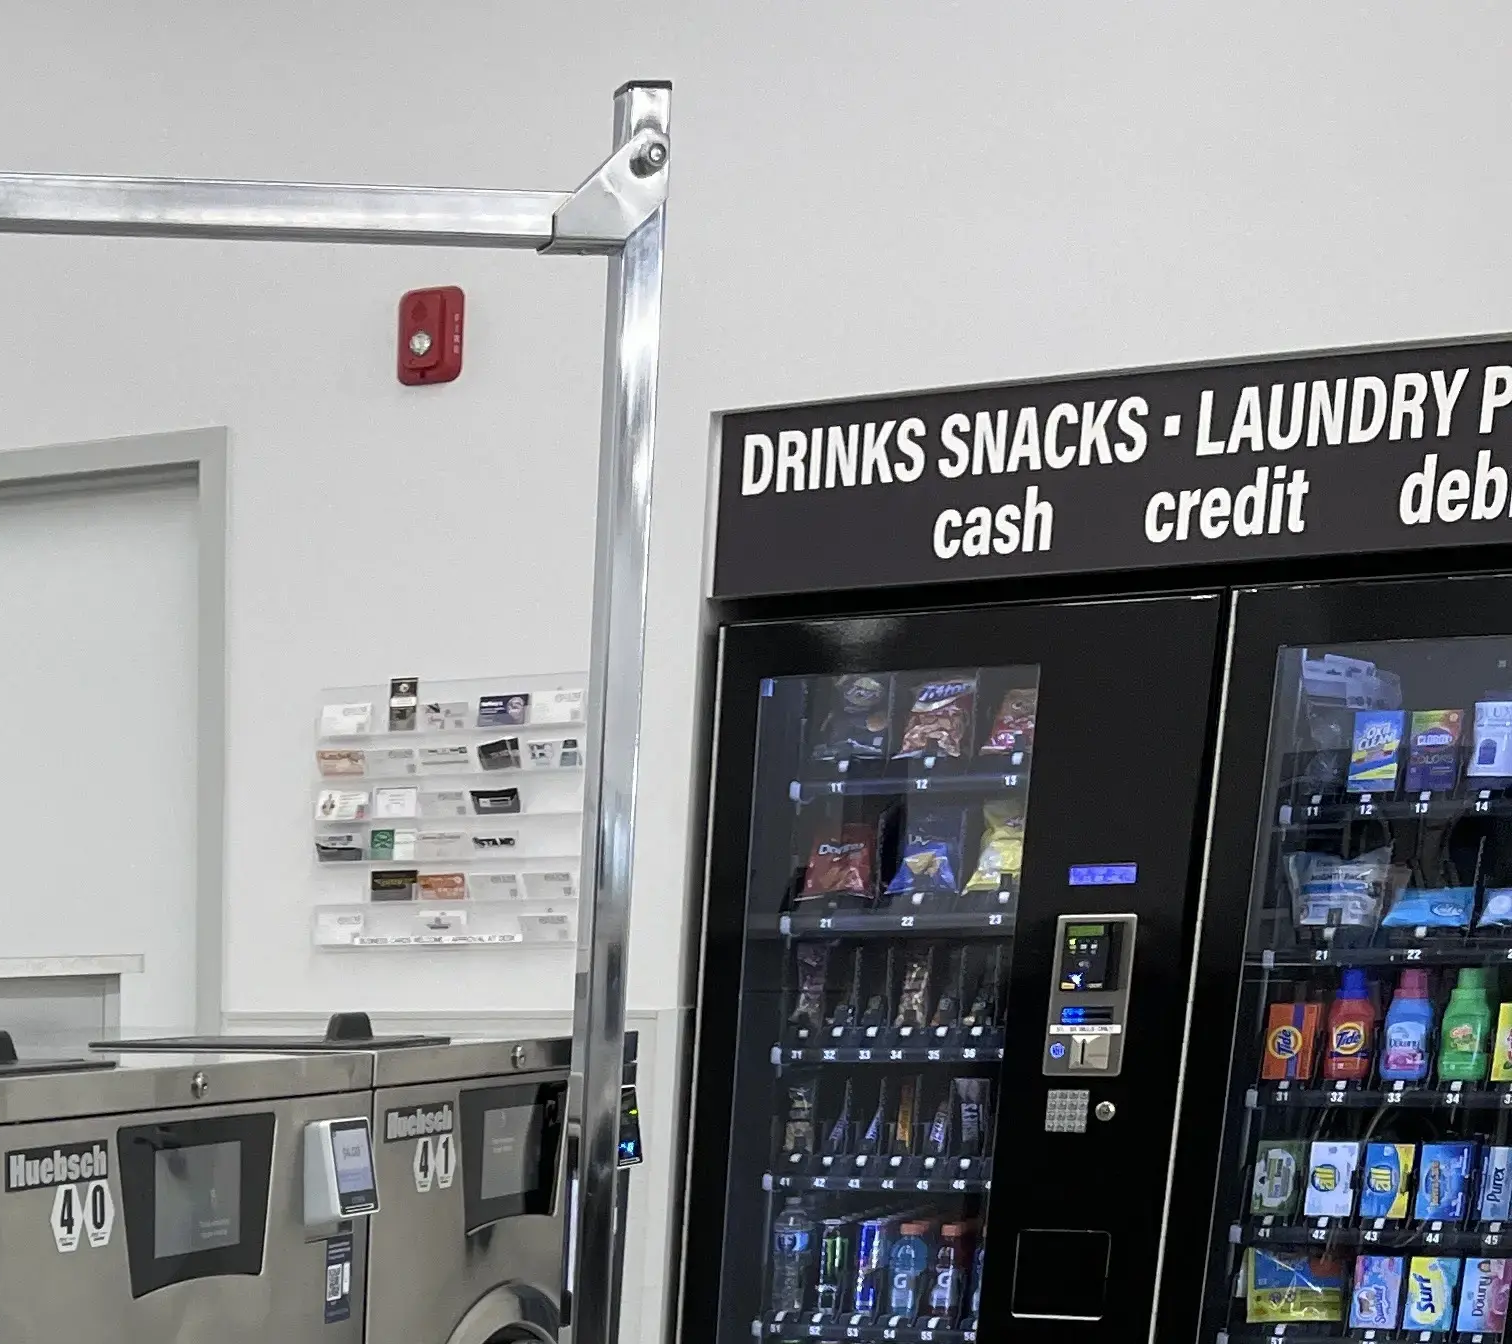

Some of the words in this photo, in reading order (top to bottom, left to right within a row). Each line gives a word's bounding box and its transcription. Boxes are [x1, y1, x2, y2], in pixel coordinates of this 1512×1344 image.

[741, 417, 925, 496] DRINKS
[938, 396, 1149, 479] SNACKS
[1197, 366, 1470, 457] LAUNDRY
[933, 486, 1054, 560] cash
[1145, 467, 1309, 543] credit
[1399, 451, 1512, 526] deb
[915, 780, 928, 790] 12
[1307, 806, 1319, 816] 11
[1360, 805, 1372, 815] 12
[1415, 803, 1428, 813] 13
[1475, 802, 1488, 811] 14
[820, 918, 832, 929] 21
[901, 916, 914, 927] 22
[989, 914, 1002, 925] 23
[1316, 950, 1328, 960] 21
[1407, 950, 1421, 960] 22
[1276, 1029, 1292, 1056] Tide
[1336, 1031, 1362, 1048] Tide
[1276, 1092, 1288, 1101] 31
[1330, 1092, 1344, 1102] 32
[1388, 1093, 1402, 1103] 33
[1446, 1094, 1460, 1104] 34
[387, 1104, 452, 1139] Huebsch
[419, 1137, 449, 1179] 41
[9, 1145, 107, 1188] Huebsch
[1488, 1167, 1505, 1203] Purex
[60, 1185, 105, 1235] 40
[1258, 1228, 1270, 1238] 41
[1312, 1229, 1326, 1240] 42
[1364, 1231, 1378, 1241] 43
[1426, 1232, 1440, 1243] 44
[1485, 1234, 1499, 1245] 45
[894, 1273, 908, 1289] G
[1412, 1272, 1436, 1314] Surf
[1471, 1274, 1492, 1317] Downy
